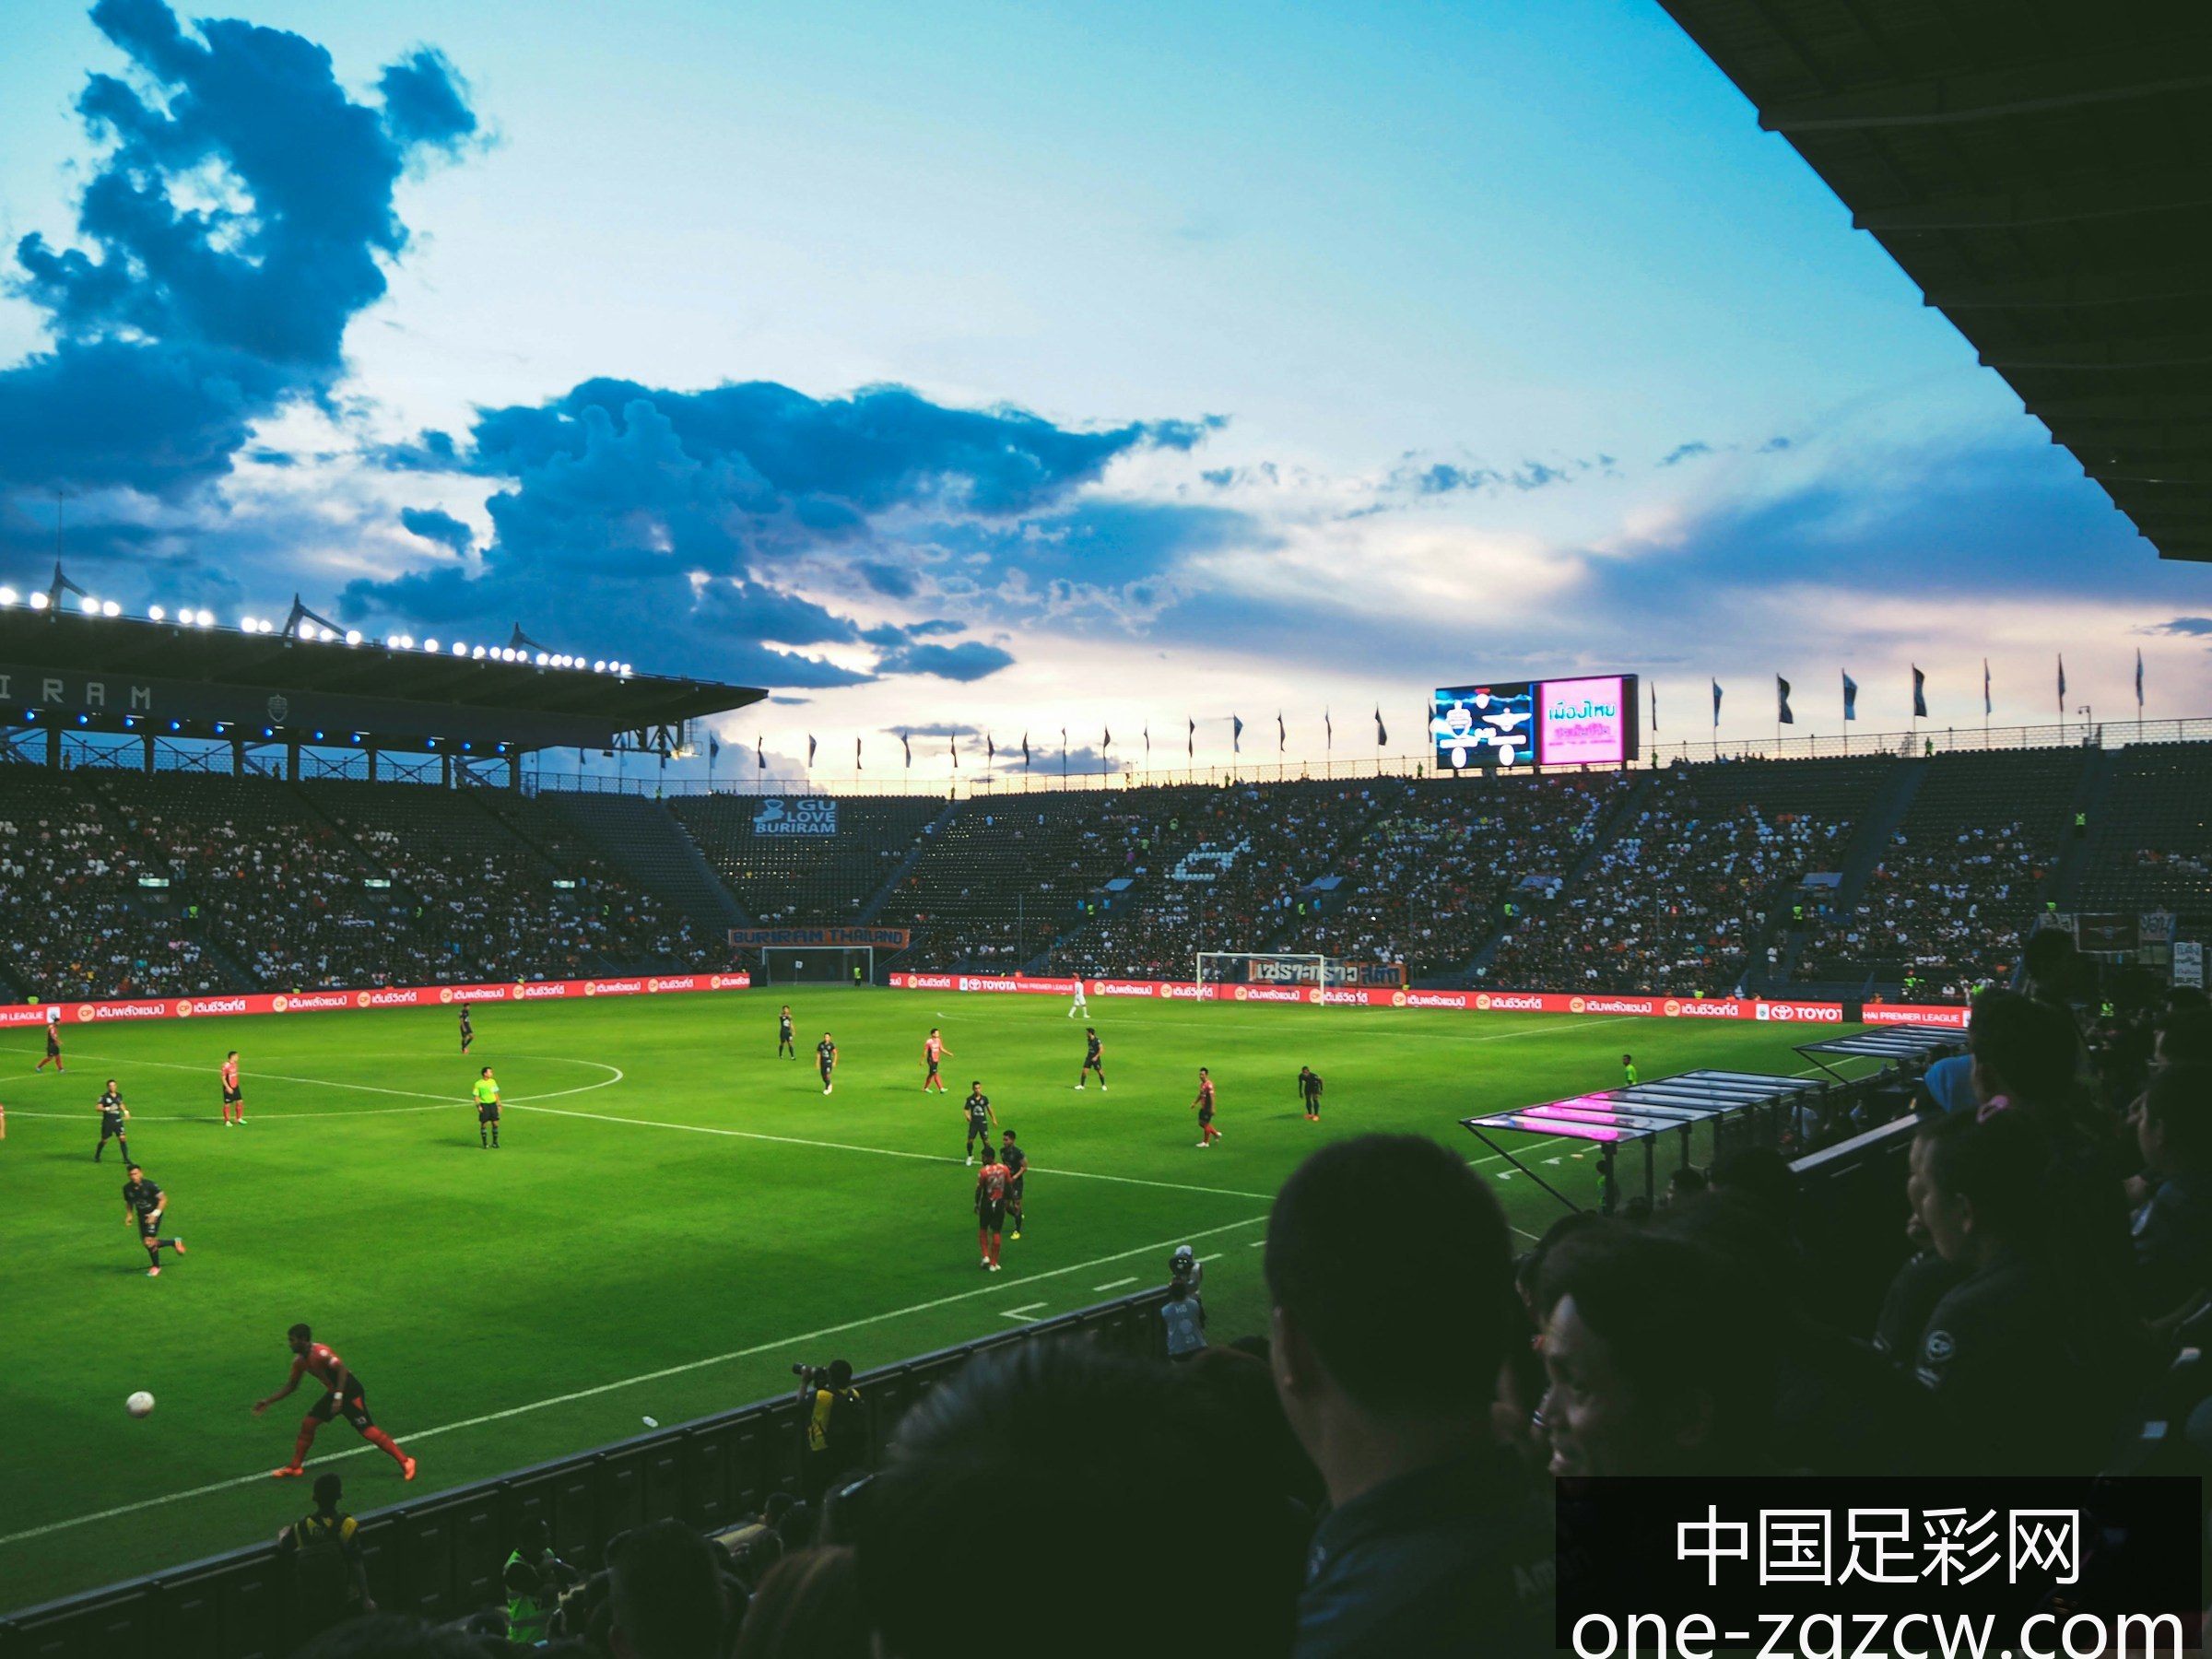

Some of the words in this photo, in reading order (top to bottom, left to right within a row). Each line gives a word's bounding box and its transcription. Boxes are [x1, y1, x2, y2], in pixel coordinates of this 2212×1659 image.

[796, 799, 837, 811] GU
[786, 811, 836, 822] LOVE
[756, 822, 836, 833] BURIRAM
[733, 929, 823, 944] BURIRAM
[830, 928, 903, 945] THAILAND
[982, 980, 1018, 991] TOYOTA
[1053, 983, 1074, 992] LEAGUE
[9, 1010, 44, 1021] LEAGUE
[1879, 1012, 1921, 1022] PREMIER
[1923, 1014, 1959, 1023] LEAGUE
